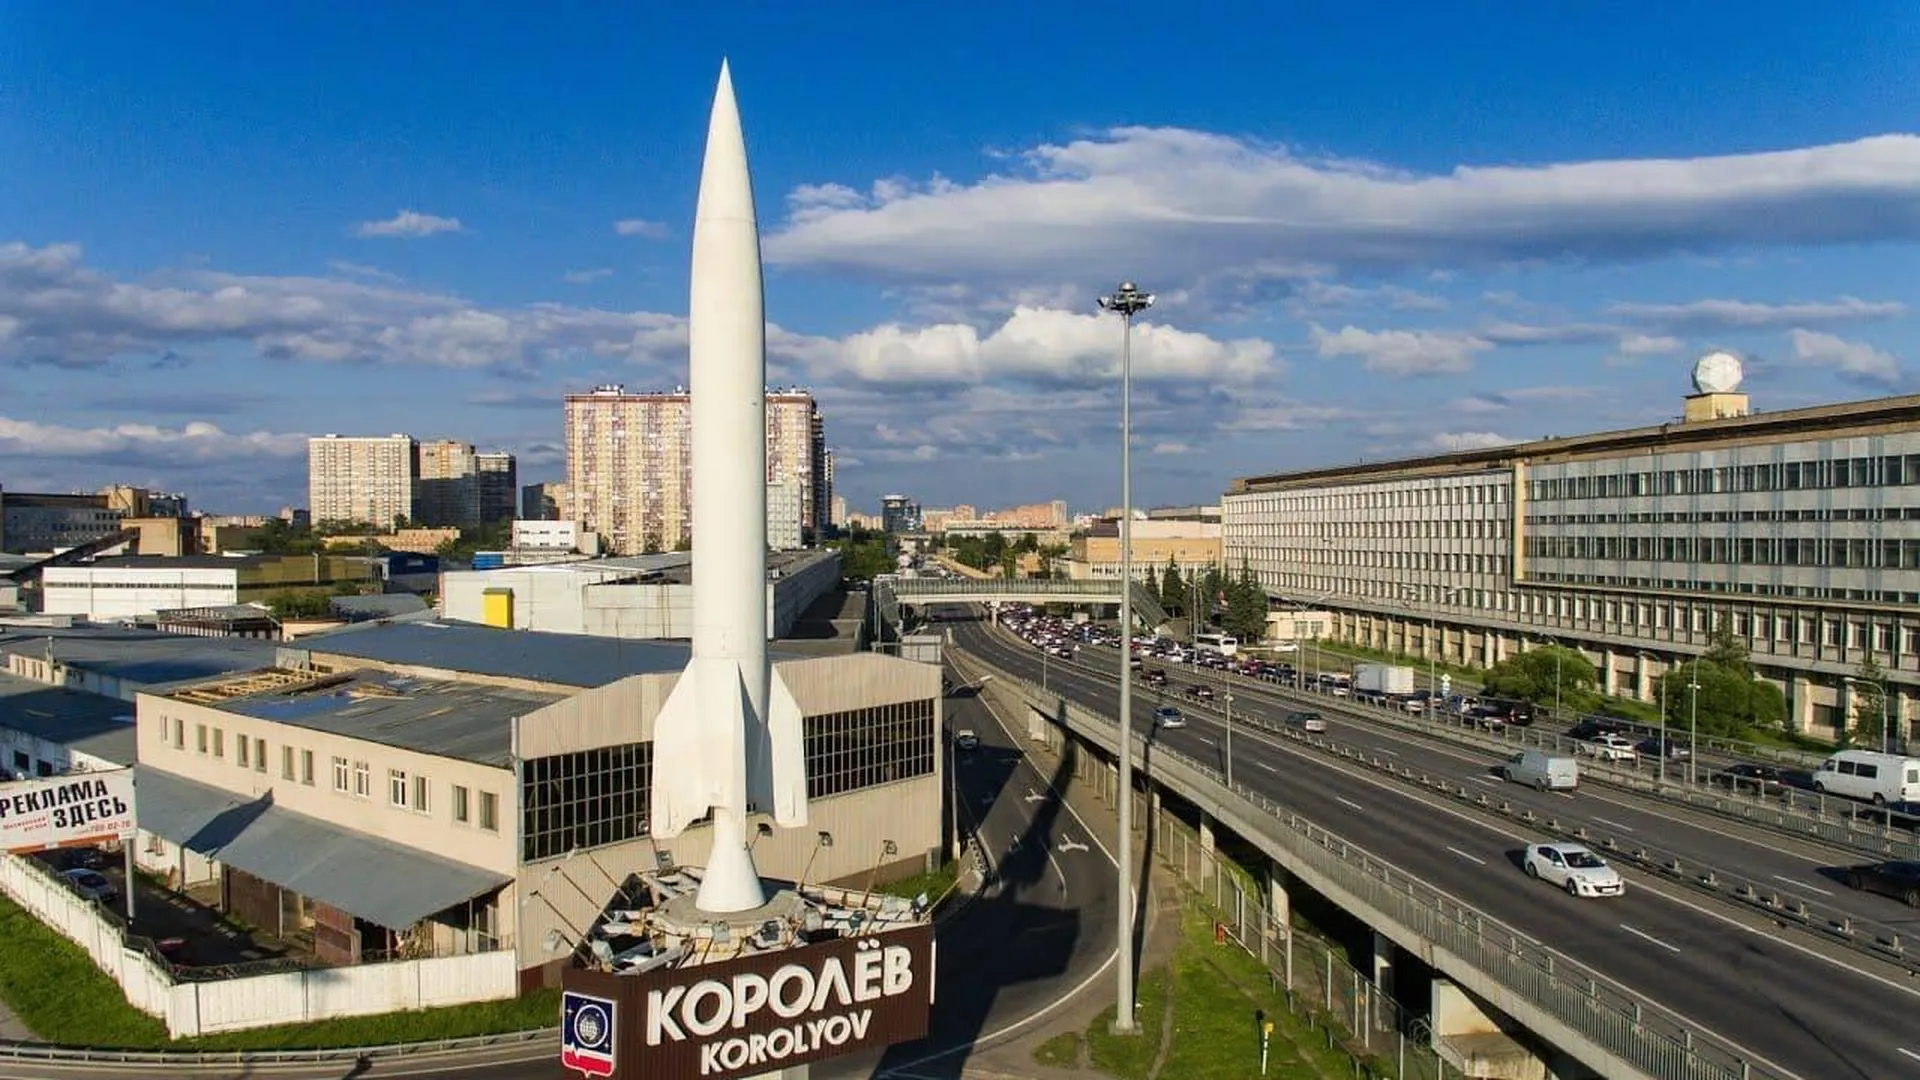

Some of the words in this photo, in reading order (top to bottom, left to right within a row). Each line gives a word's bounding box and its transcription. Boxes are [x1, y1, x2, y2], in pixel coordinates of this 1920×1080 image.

[0, 780, 108, 818] РЕКЛАМА
[53, 797, 127, 828] ЗДЕСЬ
[647, 939, 913, 1046] КОРОЛЁВ
[701, 1009, 872, 1075] KOROLYOV
